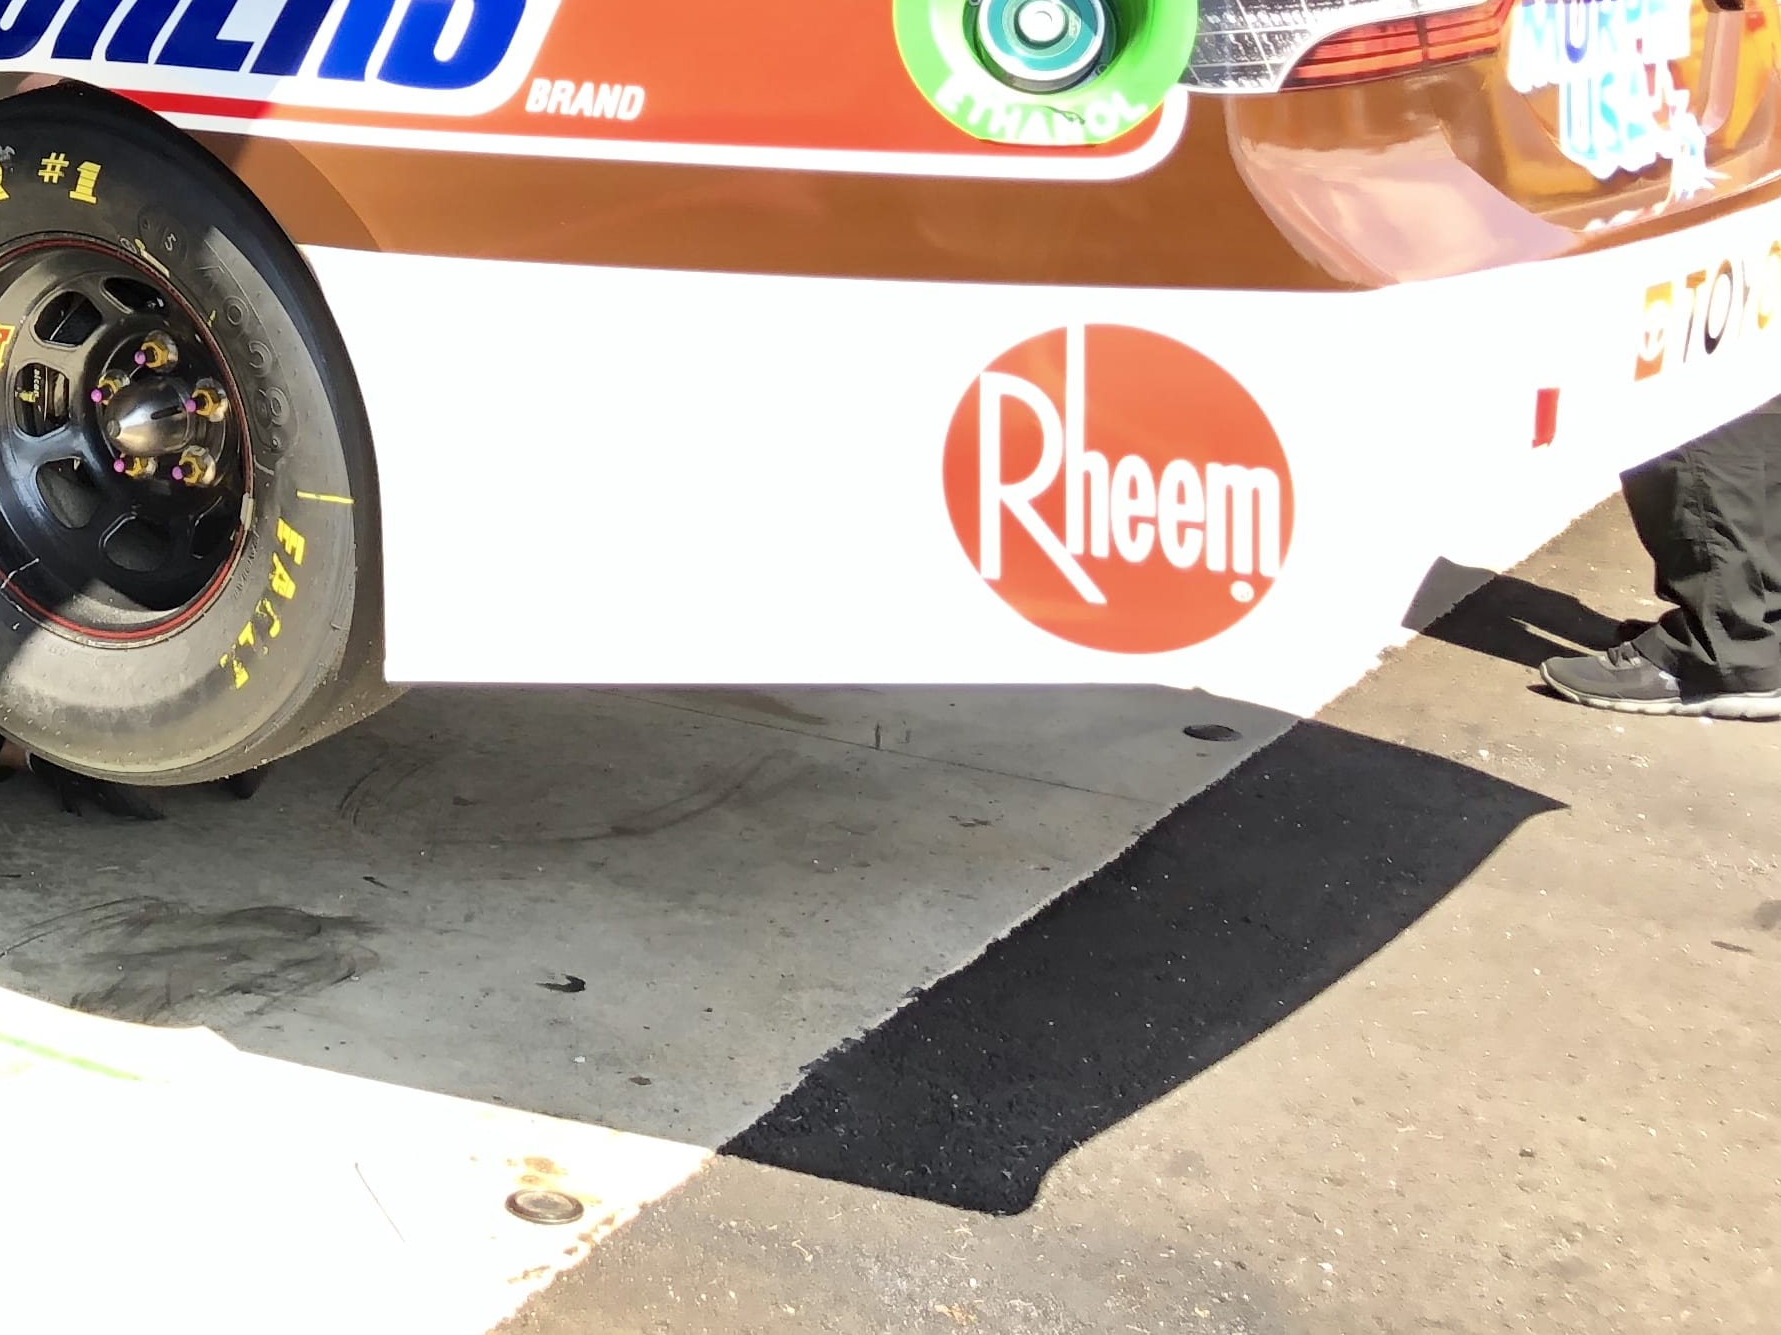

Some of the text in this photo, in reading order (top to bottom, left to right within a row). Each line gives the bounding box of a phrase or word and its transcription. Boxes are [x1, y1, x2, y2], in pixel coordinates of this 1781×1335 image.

[525, 77, 644, 122] BRAND
[37, 152, 101, 205] #1
[979, 323, 1284, 605] Rheem
